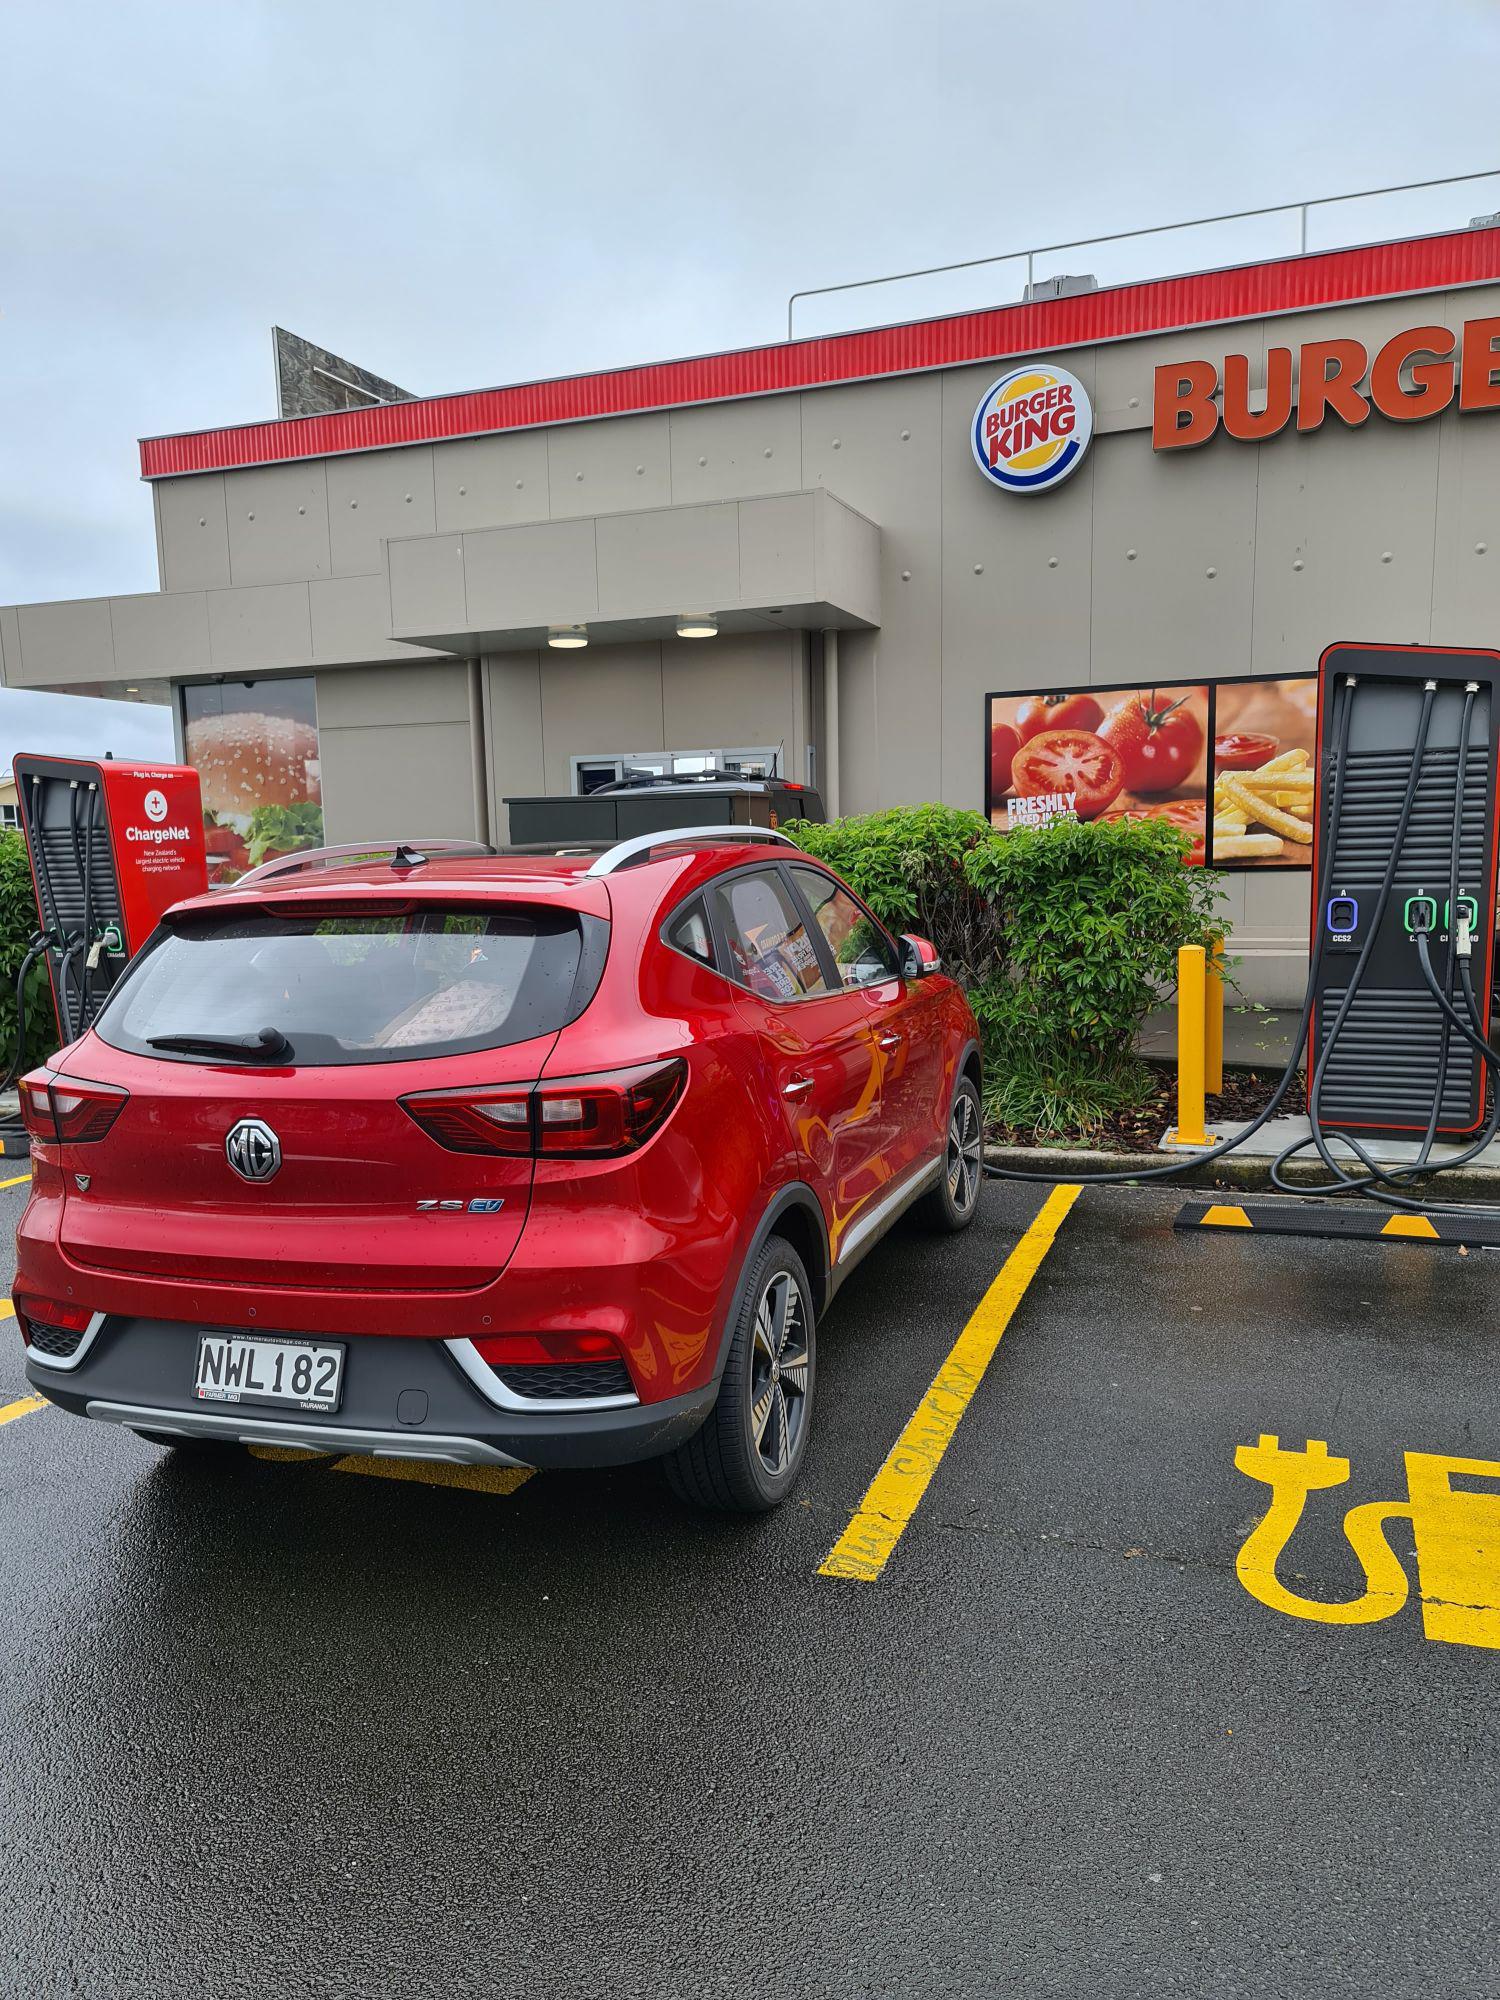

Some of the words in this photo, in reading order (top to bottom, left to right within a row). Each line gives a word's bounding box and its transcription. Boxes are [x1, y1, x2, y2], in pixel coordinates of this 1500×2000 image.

[986, 384, 1073, 438] BURGER
[988, 404, 1076, 468] KING
[133, 771, 145, 779] Plug
[150, 771, 168, 780] Charge
[1007, 791, 1077, 816] FRESHLY
[125, 826, 190, 844] ChargeNet
[155, 849, 177, 857] Zealand's
[135, 858, 152, 866] largest
[1340, 889, 1347, 897] A
[1332, 934, 1352, 942] CCS2
[229, 1127, 274, 1176] MG
[416, 1200, 464, 1211] ZS
[470, 1199, 502, 1211] EV
[205, 1390, 226, 1400] FARMER
[227, 1393, 238, 1401] MG
[299, 1401, 329, 1411] TAURANGA
